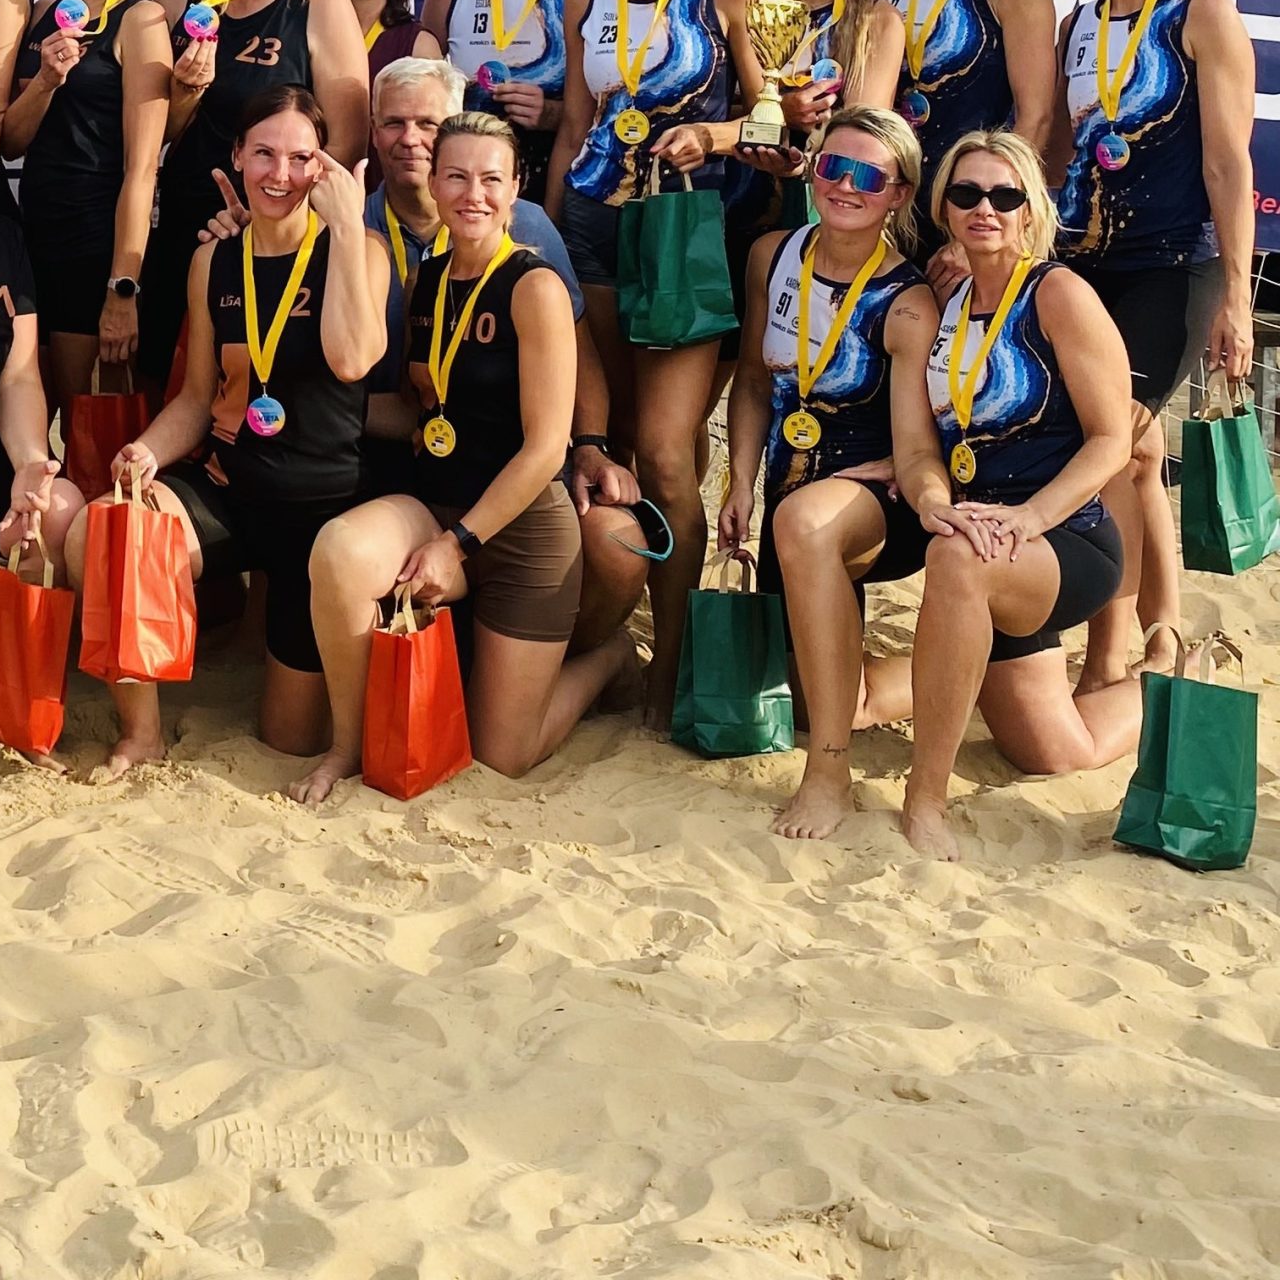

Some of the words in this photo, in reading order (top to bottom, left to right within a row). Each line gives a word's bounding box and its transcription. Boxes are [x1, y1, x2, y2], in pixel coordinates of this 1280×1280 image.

[473, 13, 488, 33] 13
[598, 25, 618, 44] 23
[235, 35, 282, 66] 23
[1076, 46, 1086, 67] 9
[776, 292, 793, 318] 91
